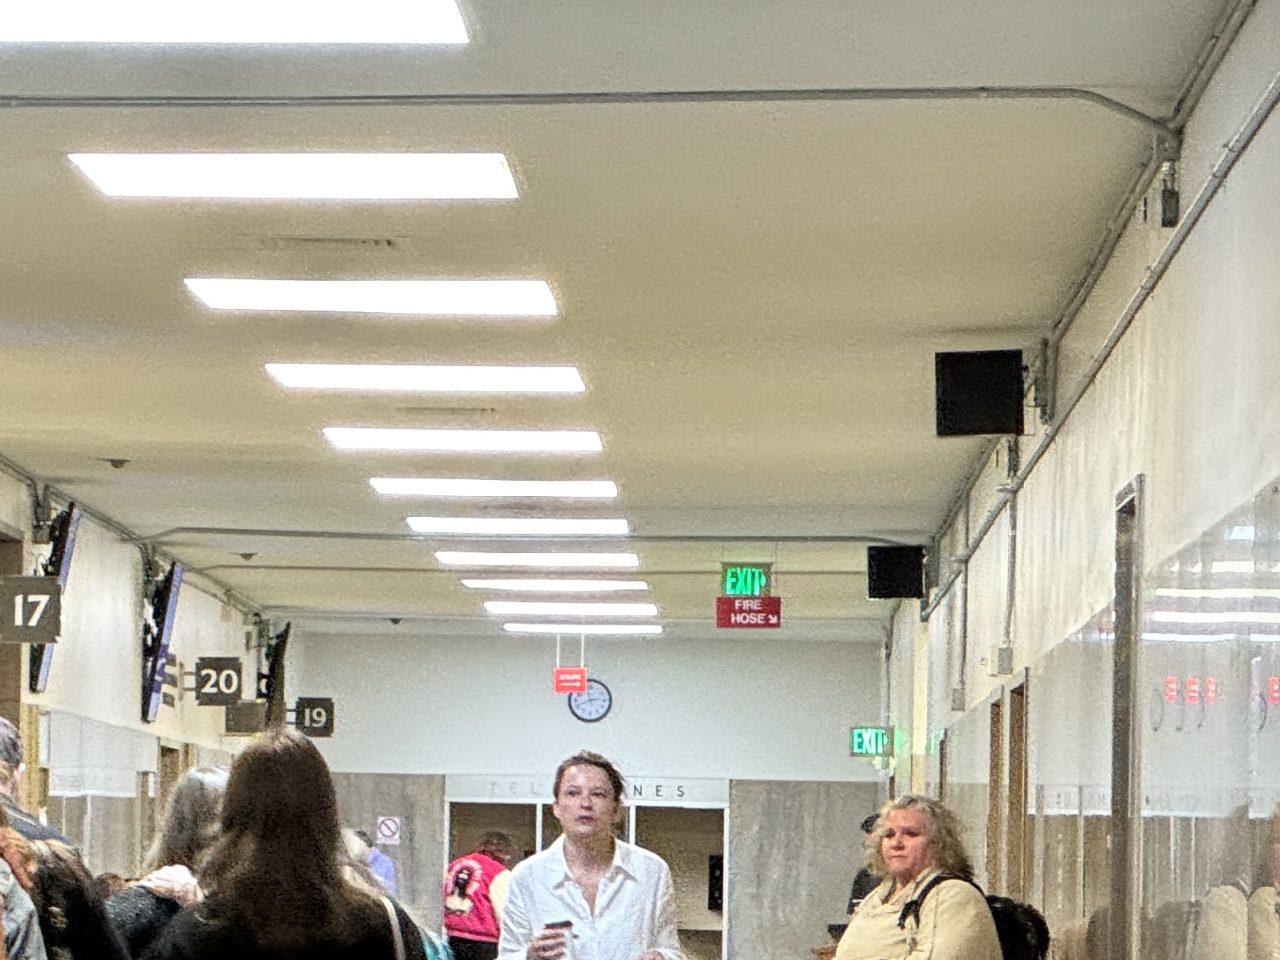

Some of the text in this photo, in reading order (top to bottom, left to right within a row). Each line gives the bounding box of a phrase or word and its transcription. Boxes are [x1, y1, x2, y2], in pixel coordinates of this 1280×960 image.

[726, 567, 763, 596] EXIT
[14, 593, 50, 627] 17
[734, 600, 762, 610] FIRE
[730, 613, 766, 624] HOSE
[200, 669, 238, 693] 20
[304, 708, 326, 727] 19
[853, 728, 885, 753] EXIT
[488, 782, 685, 797] TELNES
